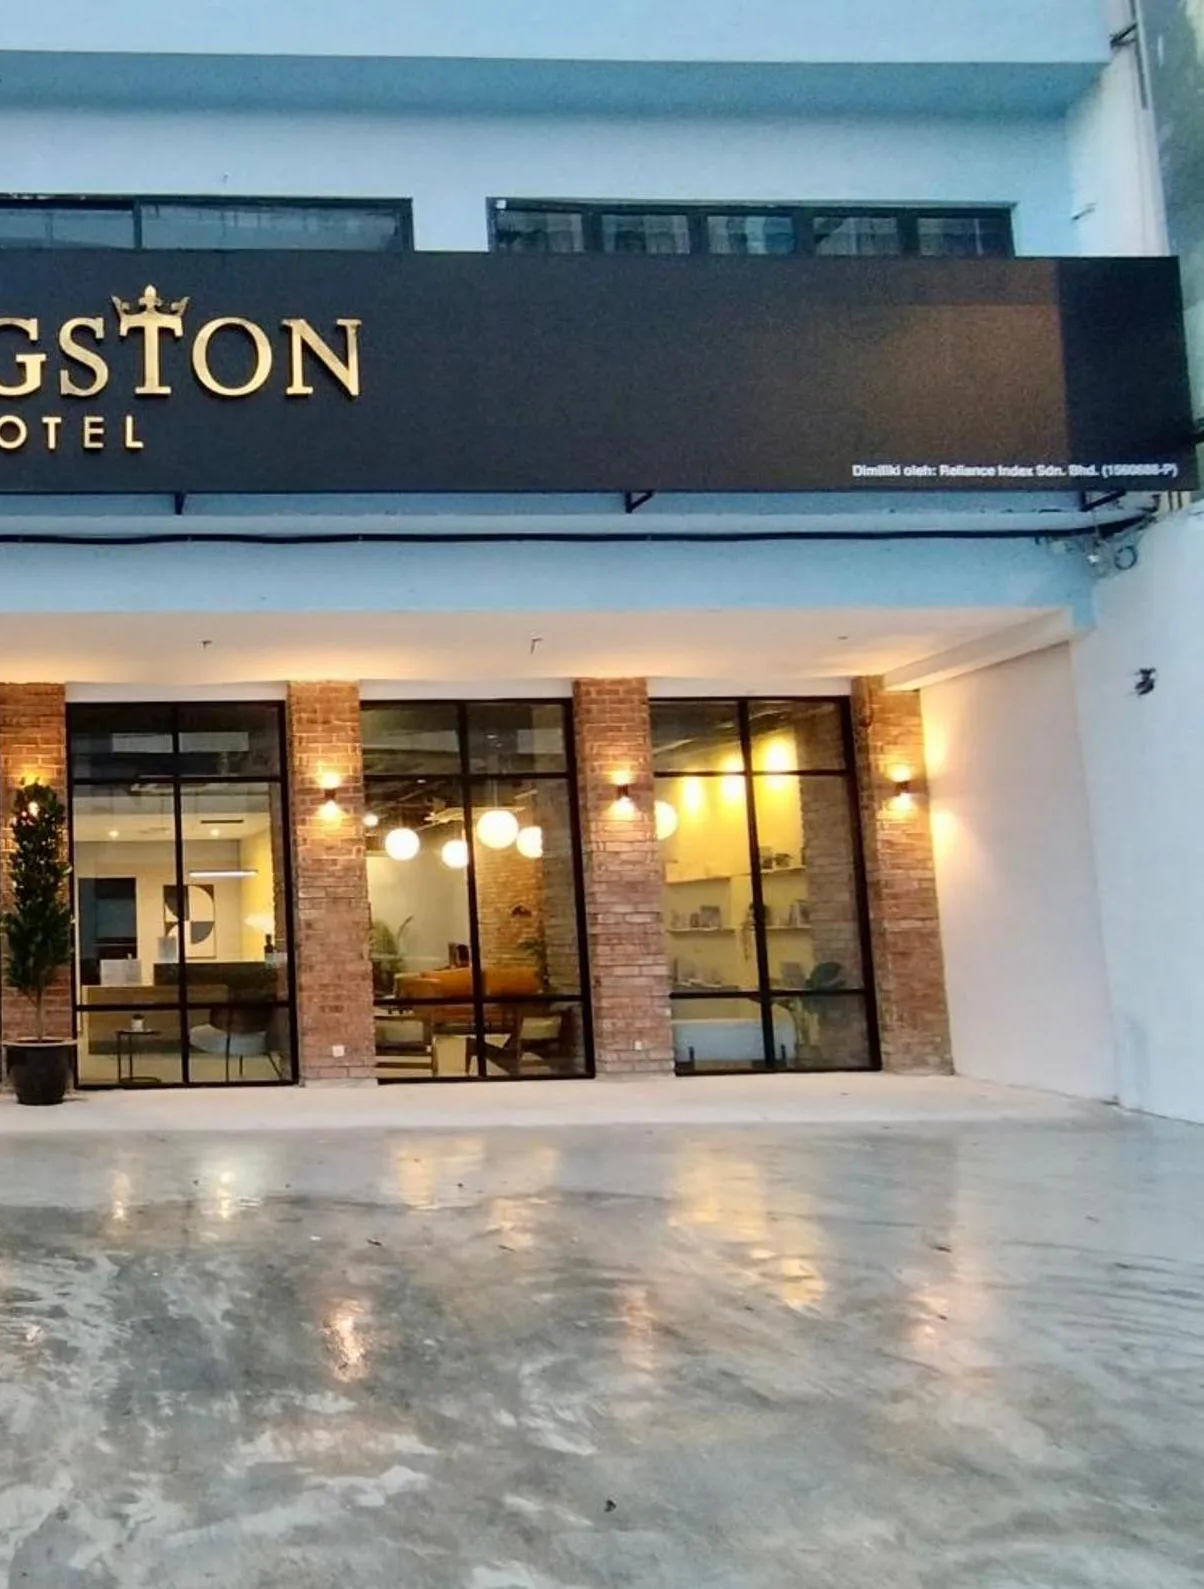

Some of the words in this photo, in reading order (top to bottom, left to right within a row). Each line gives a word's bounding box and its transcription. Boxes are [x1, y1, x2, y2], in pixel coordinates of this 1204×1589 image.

[903, 463, 937, 477] oleh:
[939, 463, 996, 477] Reliance
[998, 463, 1034, 477] Index
[1035, 463, 1067, 477] Sdn.
[1068, 463, 1099, 477] Bhd.
